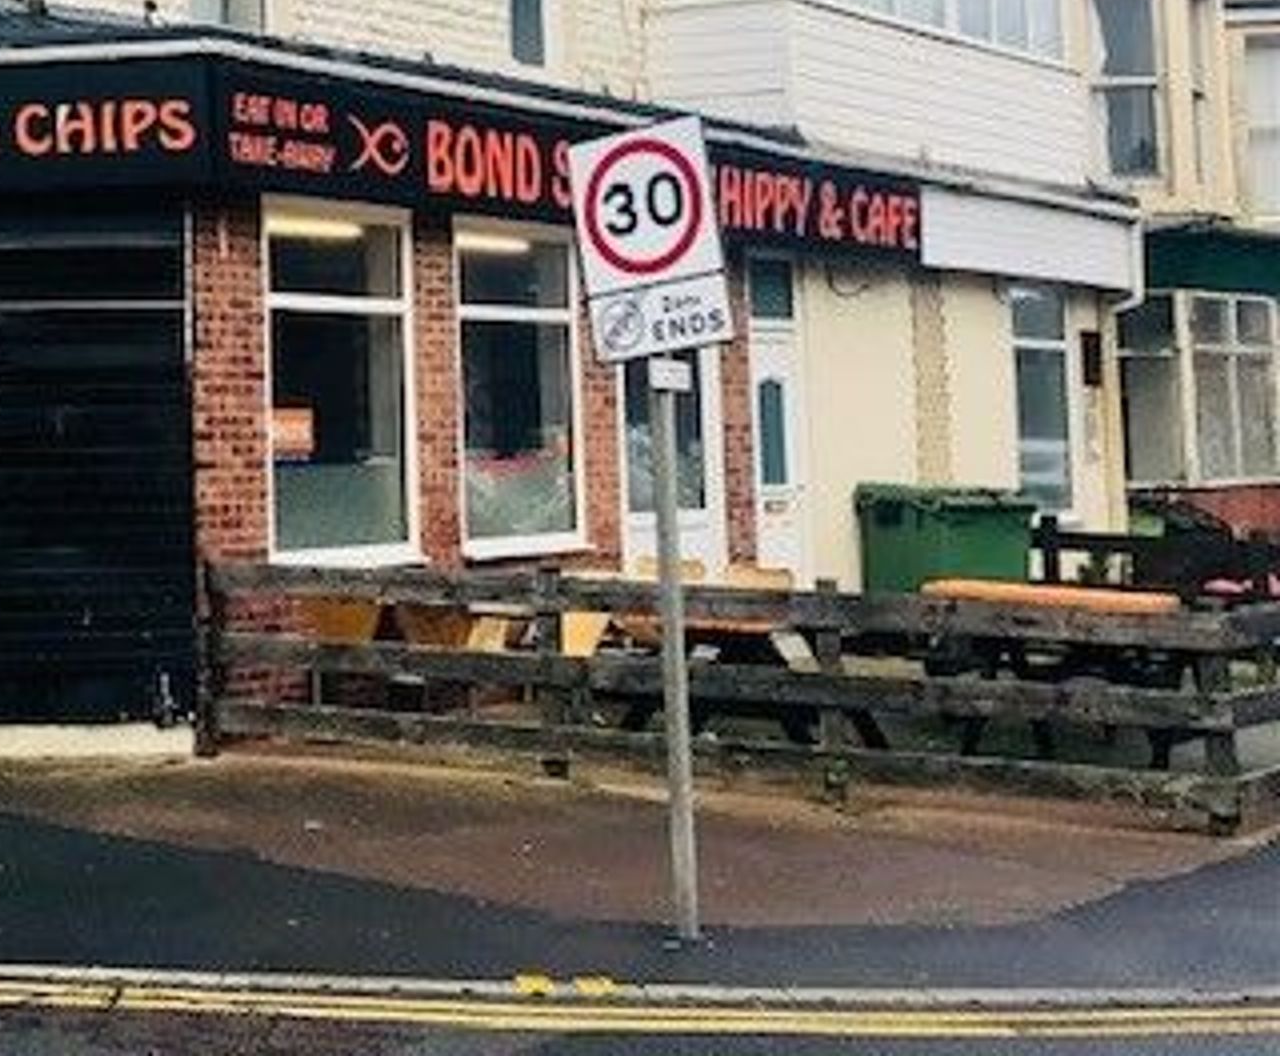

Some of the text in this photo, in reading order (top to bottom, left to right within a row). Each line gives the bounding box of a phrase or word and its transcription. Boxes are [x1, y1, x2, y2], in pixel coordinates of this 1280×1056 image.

[15, 99, 196, 155] CHIPS
[234, 93, 271, 125] EAT
[300, 103, 329, 134] OR
[426, 119, 542, 202] BOND
[718, 164, 812, 237] HIPPY
[818, 178, 844, 240] &
[850, 187, 918, 250] CAFE
[603, 171, 683, 236] 30
[651, 308, 726, 341] ENDS
